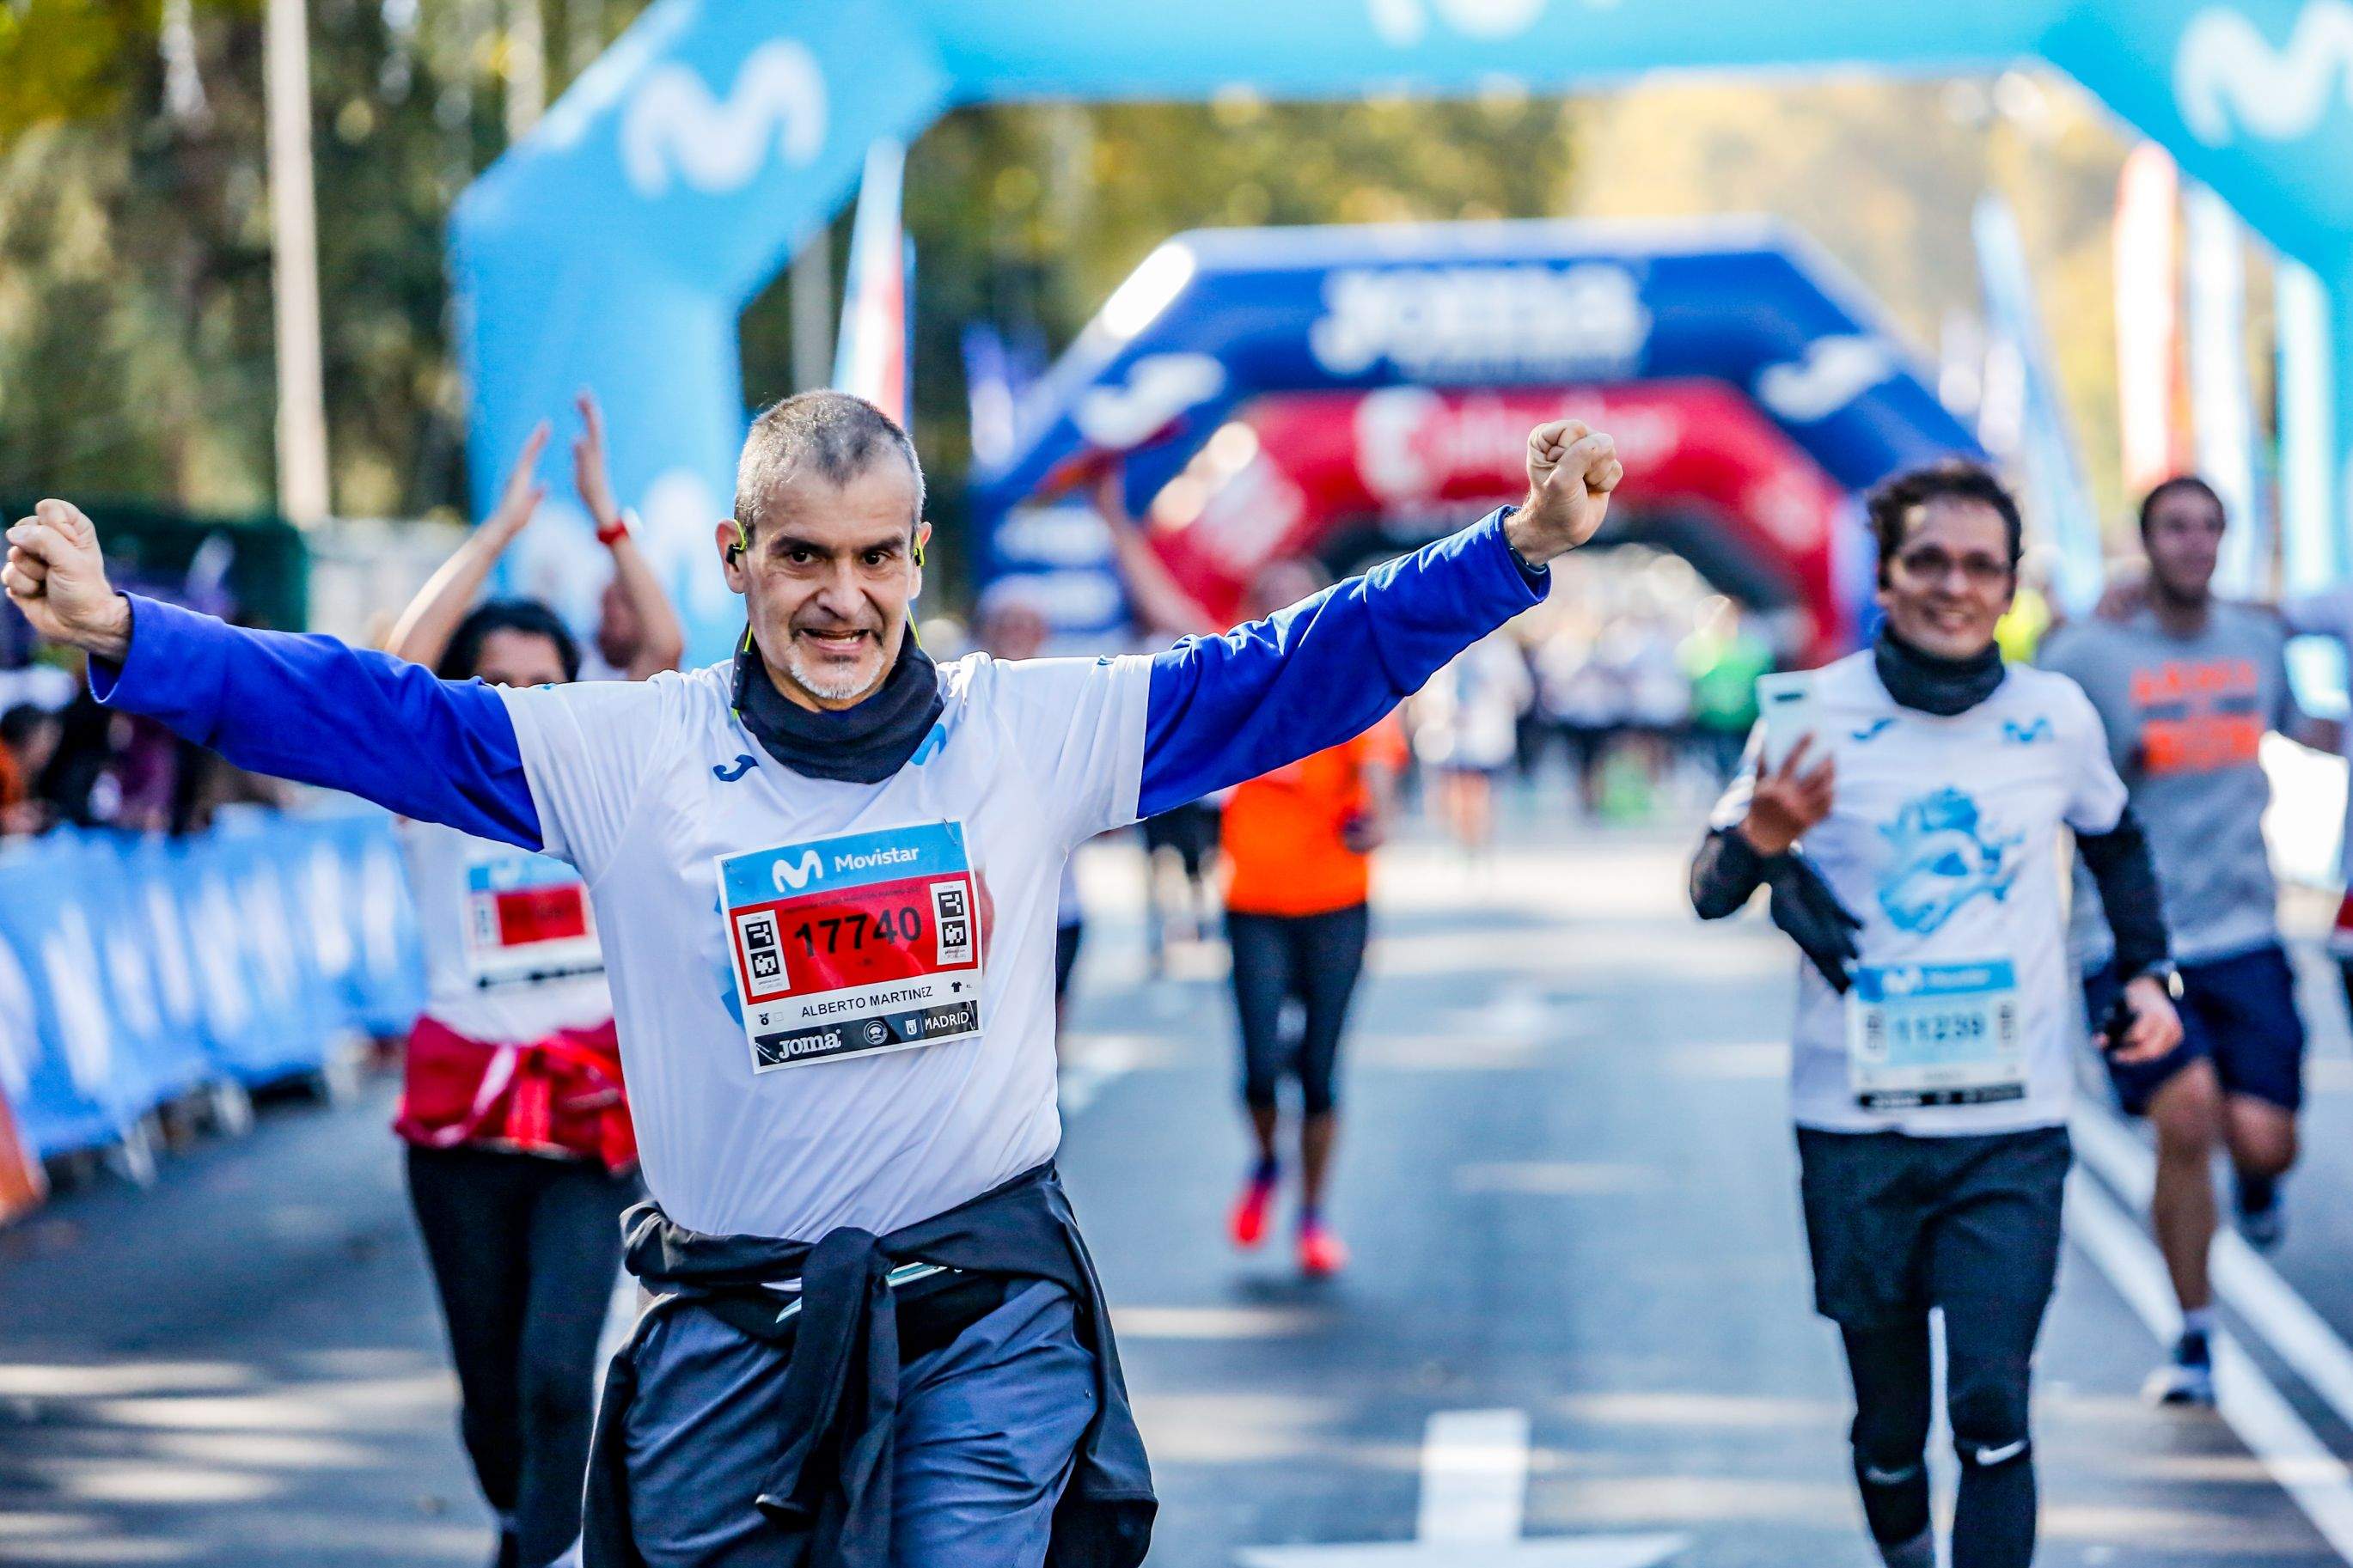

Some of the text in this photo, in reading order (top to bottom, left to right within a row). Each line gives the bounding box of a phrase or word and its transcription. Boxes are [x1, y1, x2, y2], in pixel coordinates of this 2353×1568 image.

[834, 846, 920, 873] Movistar
[795, 906, 922, 957] 17740
[802, 986, 933, 1017] ALBERTO MARTINEZ
[925, 1011, 969, 1030] MADRID
